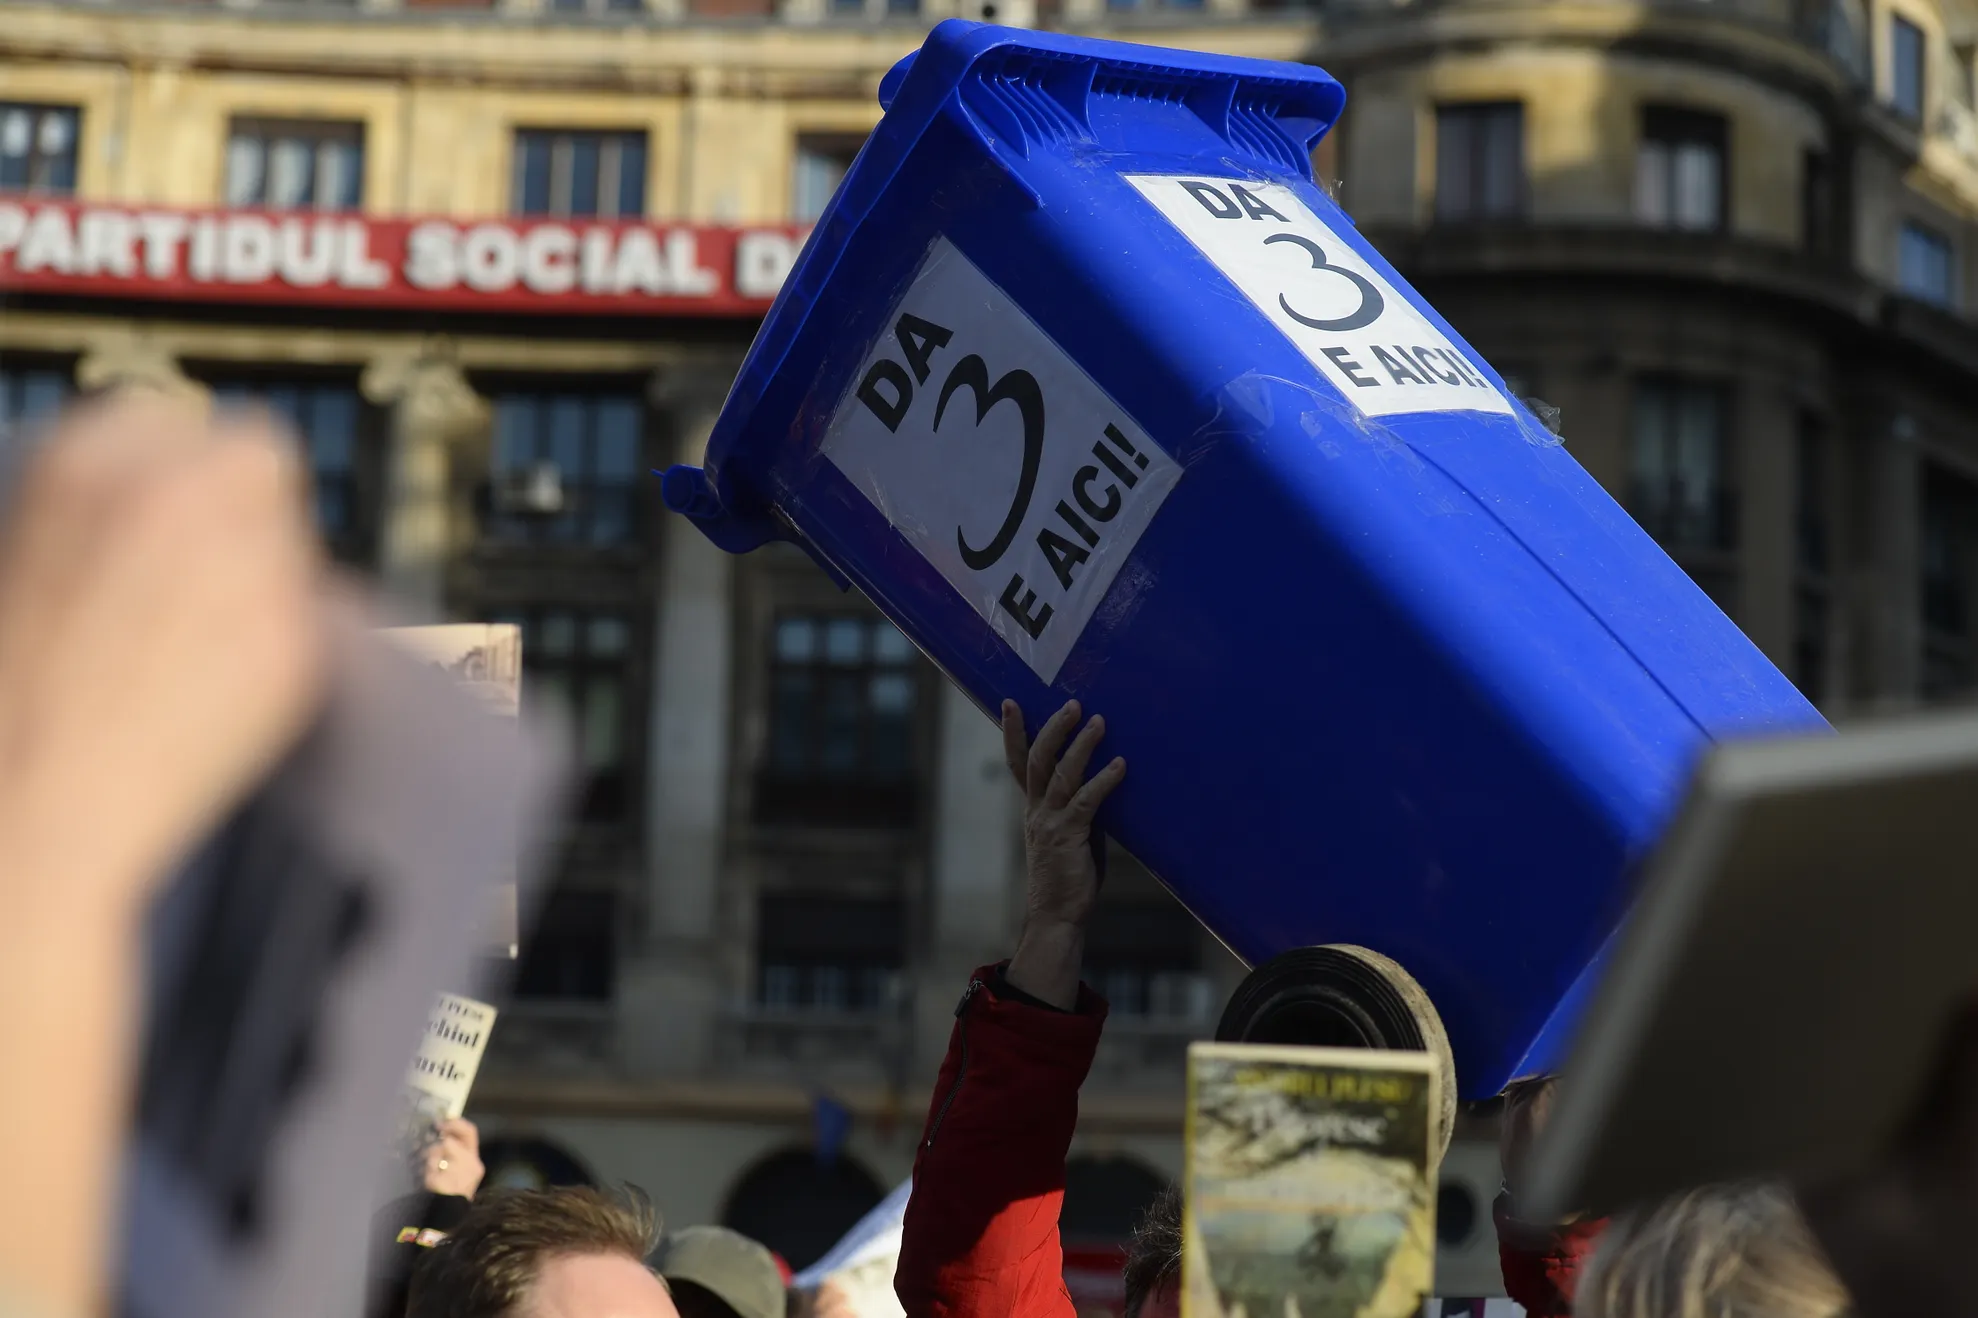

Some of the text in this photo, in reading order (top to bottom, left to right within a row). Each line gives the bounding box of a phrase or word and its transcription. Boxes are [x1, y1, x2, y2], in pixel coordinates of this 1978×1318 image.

[0, 201, 389, 289] PARTIDUL
[404, 219, 716, 297] SOCIAL
[1178, 180, 1291, 223] DA
[1263, 233, 1385, 332] 3
[855, 312, 954, 434] DA
[1319, 344, 1488, 389] E AICI!
[933, 353, 1046, 571] 3
[998, 421, 1151, 641] E AICI!
